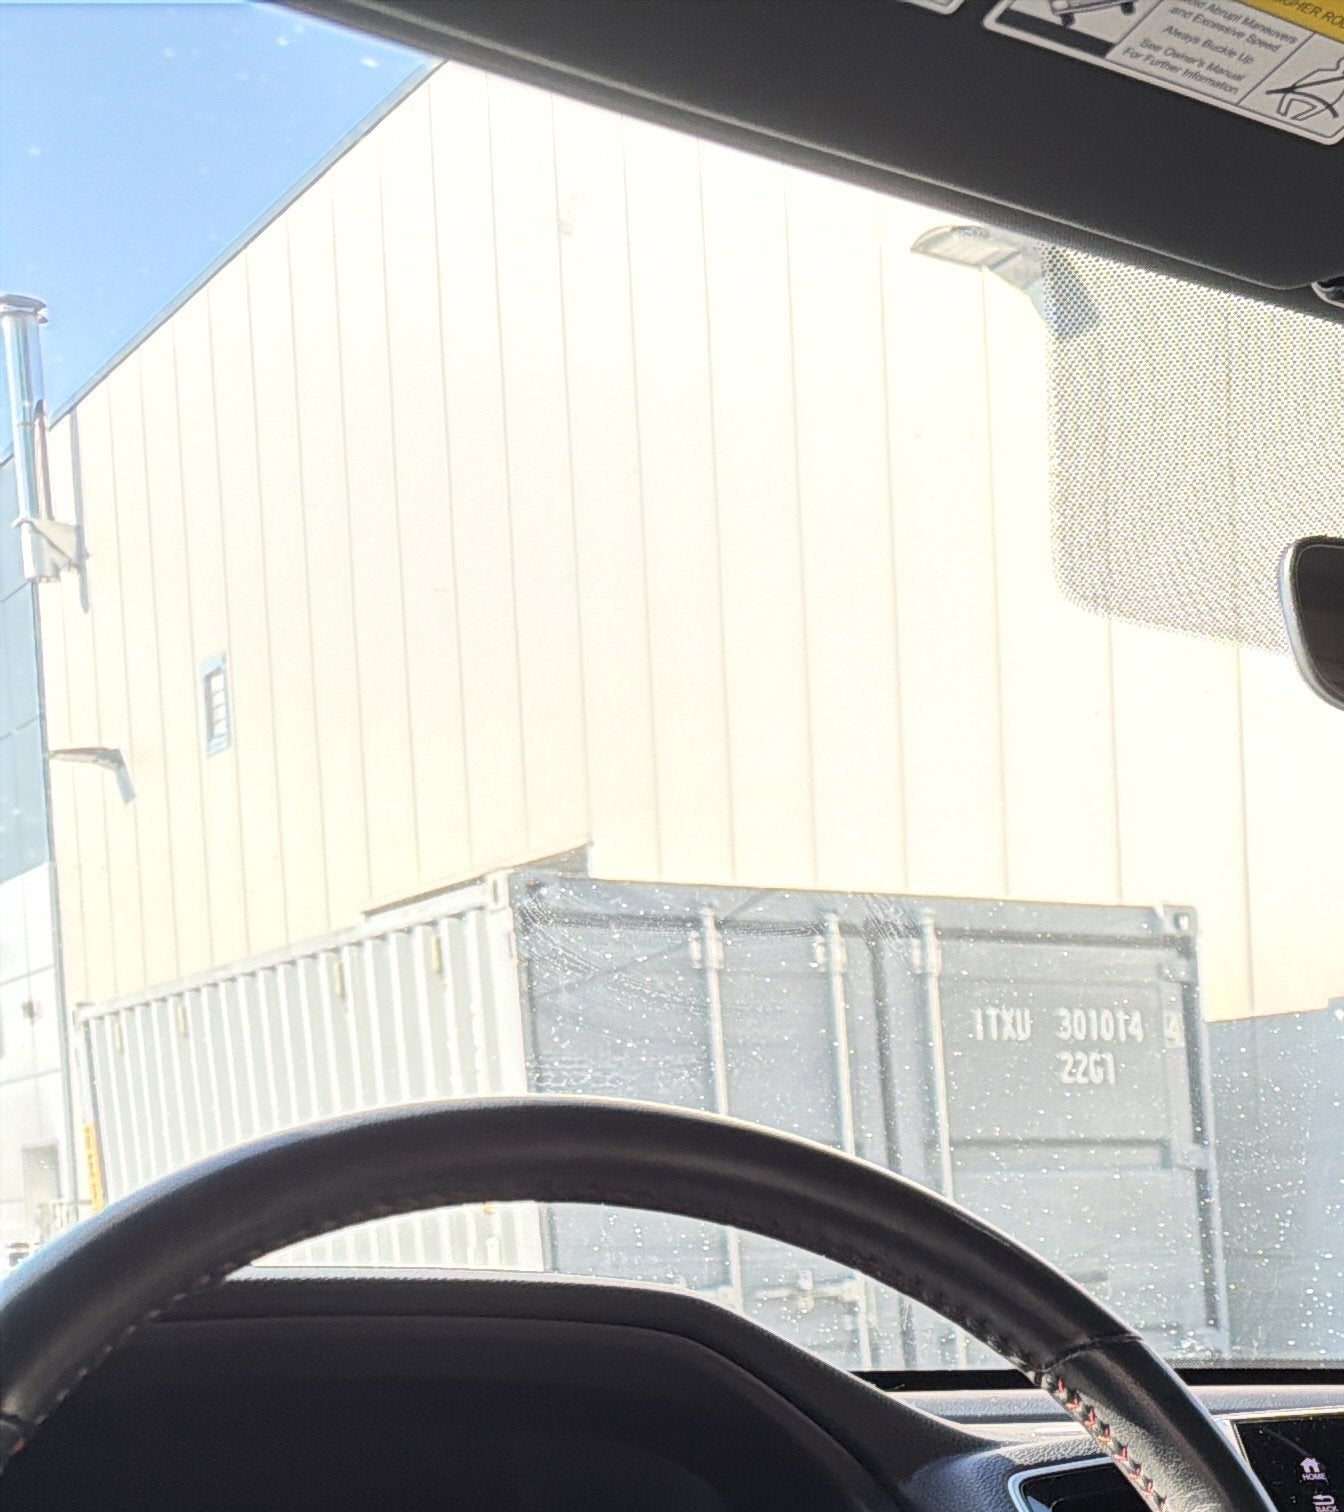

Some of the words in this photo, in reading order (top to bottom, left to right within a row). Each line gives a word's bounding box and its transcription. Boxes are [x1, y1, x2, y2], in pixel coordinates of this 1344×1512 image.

[1170, 6, 1193, 18] and
[1192, 11, 1247, 39] Excessive
[1246, 33, 1282, 53] Speed
[1205, 3, 1242, 23] Abrupt
[1243, 15, 1299, 45] Maneuvers
[1140, 38, 1162, 50] See
[1163, 43, 1205, 68] Owner's
[1207, 60, 1246, 81] Manual
[1163, 25, 1200, 45] Always
[1201, 38, 1238, 58] Buckle
[1238, 52, 1255, 66] Up
[1123, 47, 1144, 61] For
[1144, 54, 1181, 74] Further
[1182, 67, 1239, 95] Information
[1054, 1007, 1144, 1042] 301014
[1058, 1051, 1117, 1084] 22G1
[1302, 1472, 1327, 1481] HOME
